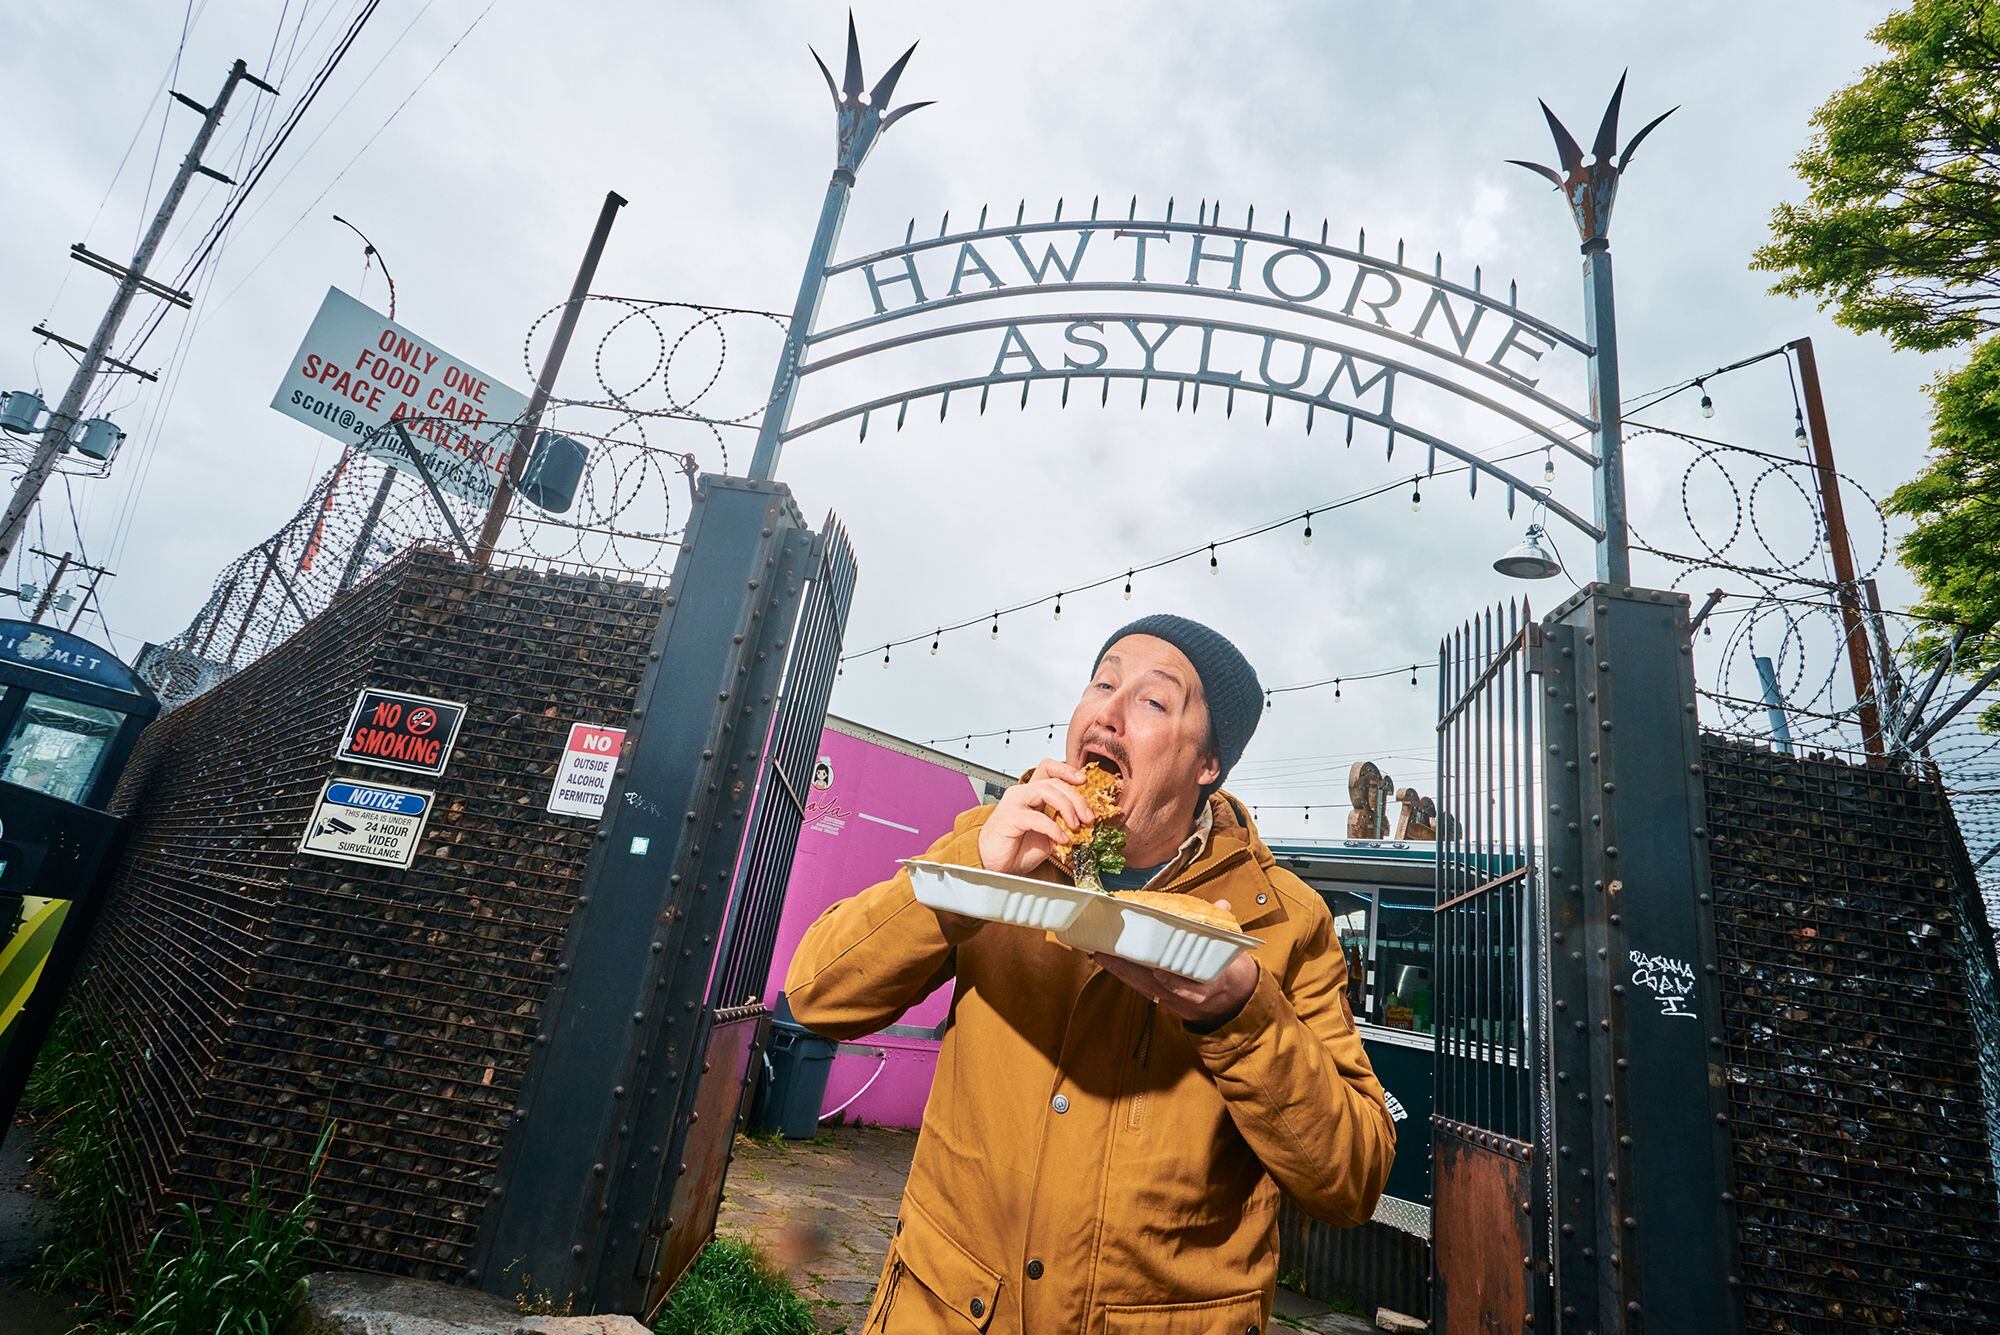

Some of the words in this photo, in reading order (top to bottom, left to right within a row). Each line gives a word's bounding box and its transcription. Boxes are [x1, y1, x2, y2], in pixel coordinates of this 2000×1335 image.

[860, 230, 1561, 390] HAWTHORNE
[378, 329, 439, 375] ONLY
[443, 366, 491, 404] ONE
[990, 320, 1400, 418] ASYLUM
[355, 348, 420, 398] FOOD
[427, 387, 488, 431] CART
[302, 353, 386, 413] SPACE
[389, 401, 510, 475] AVAILABLE
[372, 702, 402, 728] NO
[352, 727, 440, 764] SMOKING
[583, 734, 611, 752] NO
[573, 758, 609, 773] OUTSIDE
[566, 773, 605, 788] ALCOHOL
[347, 788, 406, 810] NOTICE
[558, 789, 605, 805] PERMITTED
[344, 809, 360, 818] THIS
[360, 812, 379, 820] AREA
[380, 814, 387, 822] IS
[389, 817, 412, 826] UNDER
[365, 822, 378, 832] 24
[380, 824, 409, 837] HOUR
[338, 841, 400, 859] SURVEILLANCE
[368, 834, 398, 848] VIDEO
